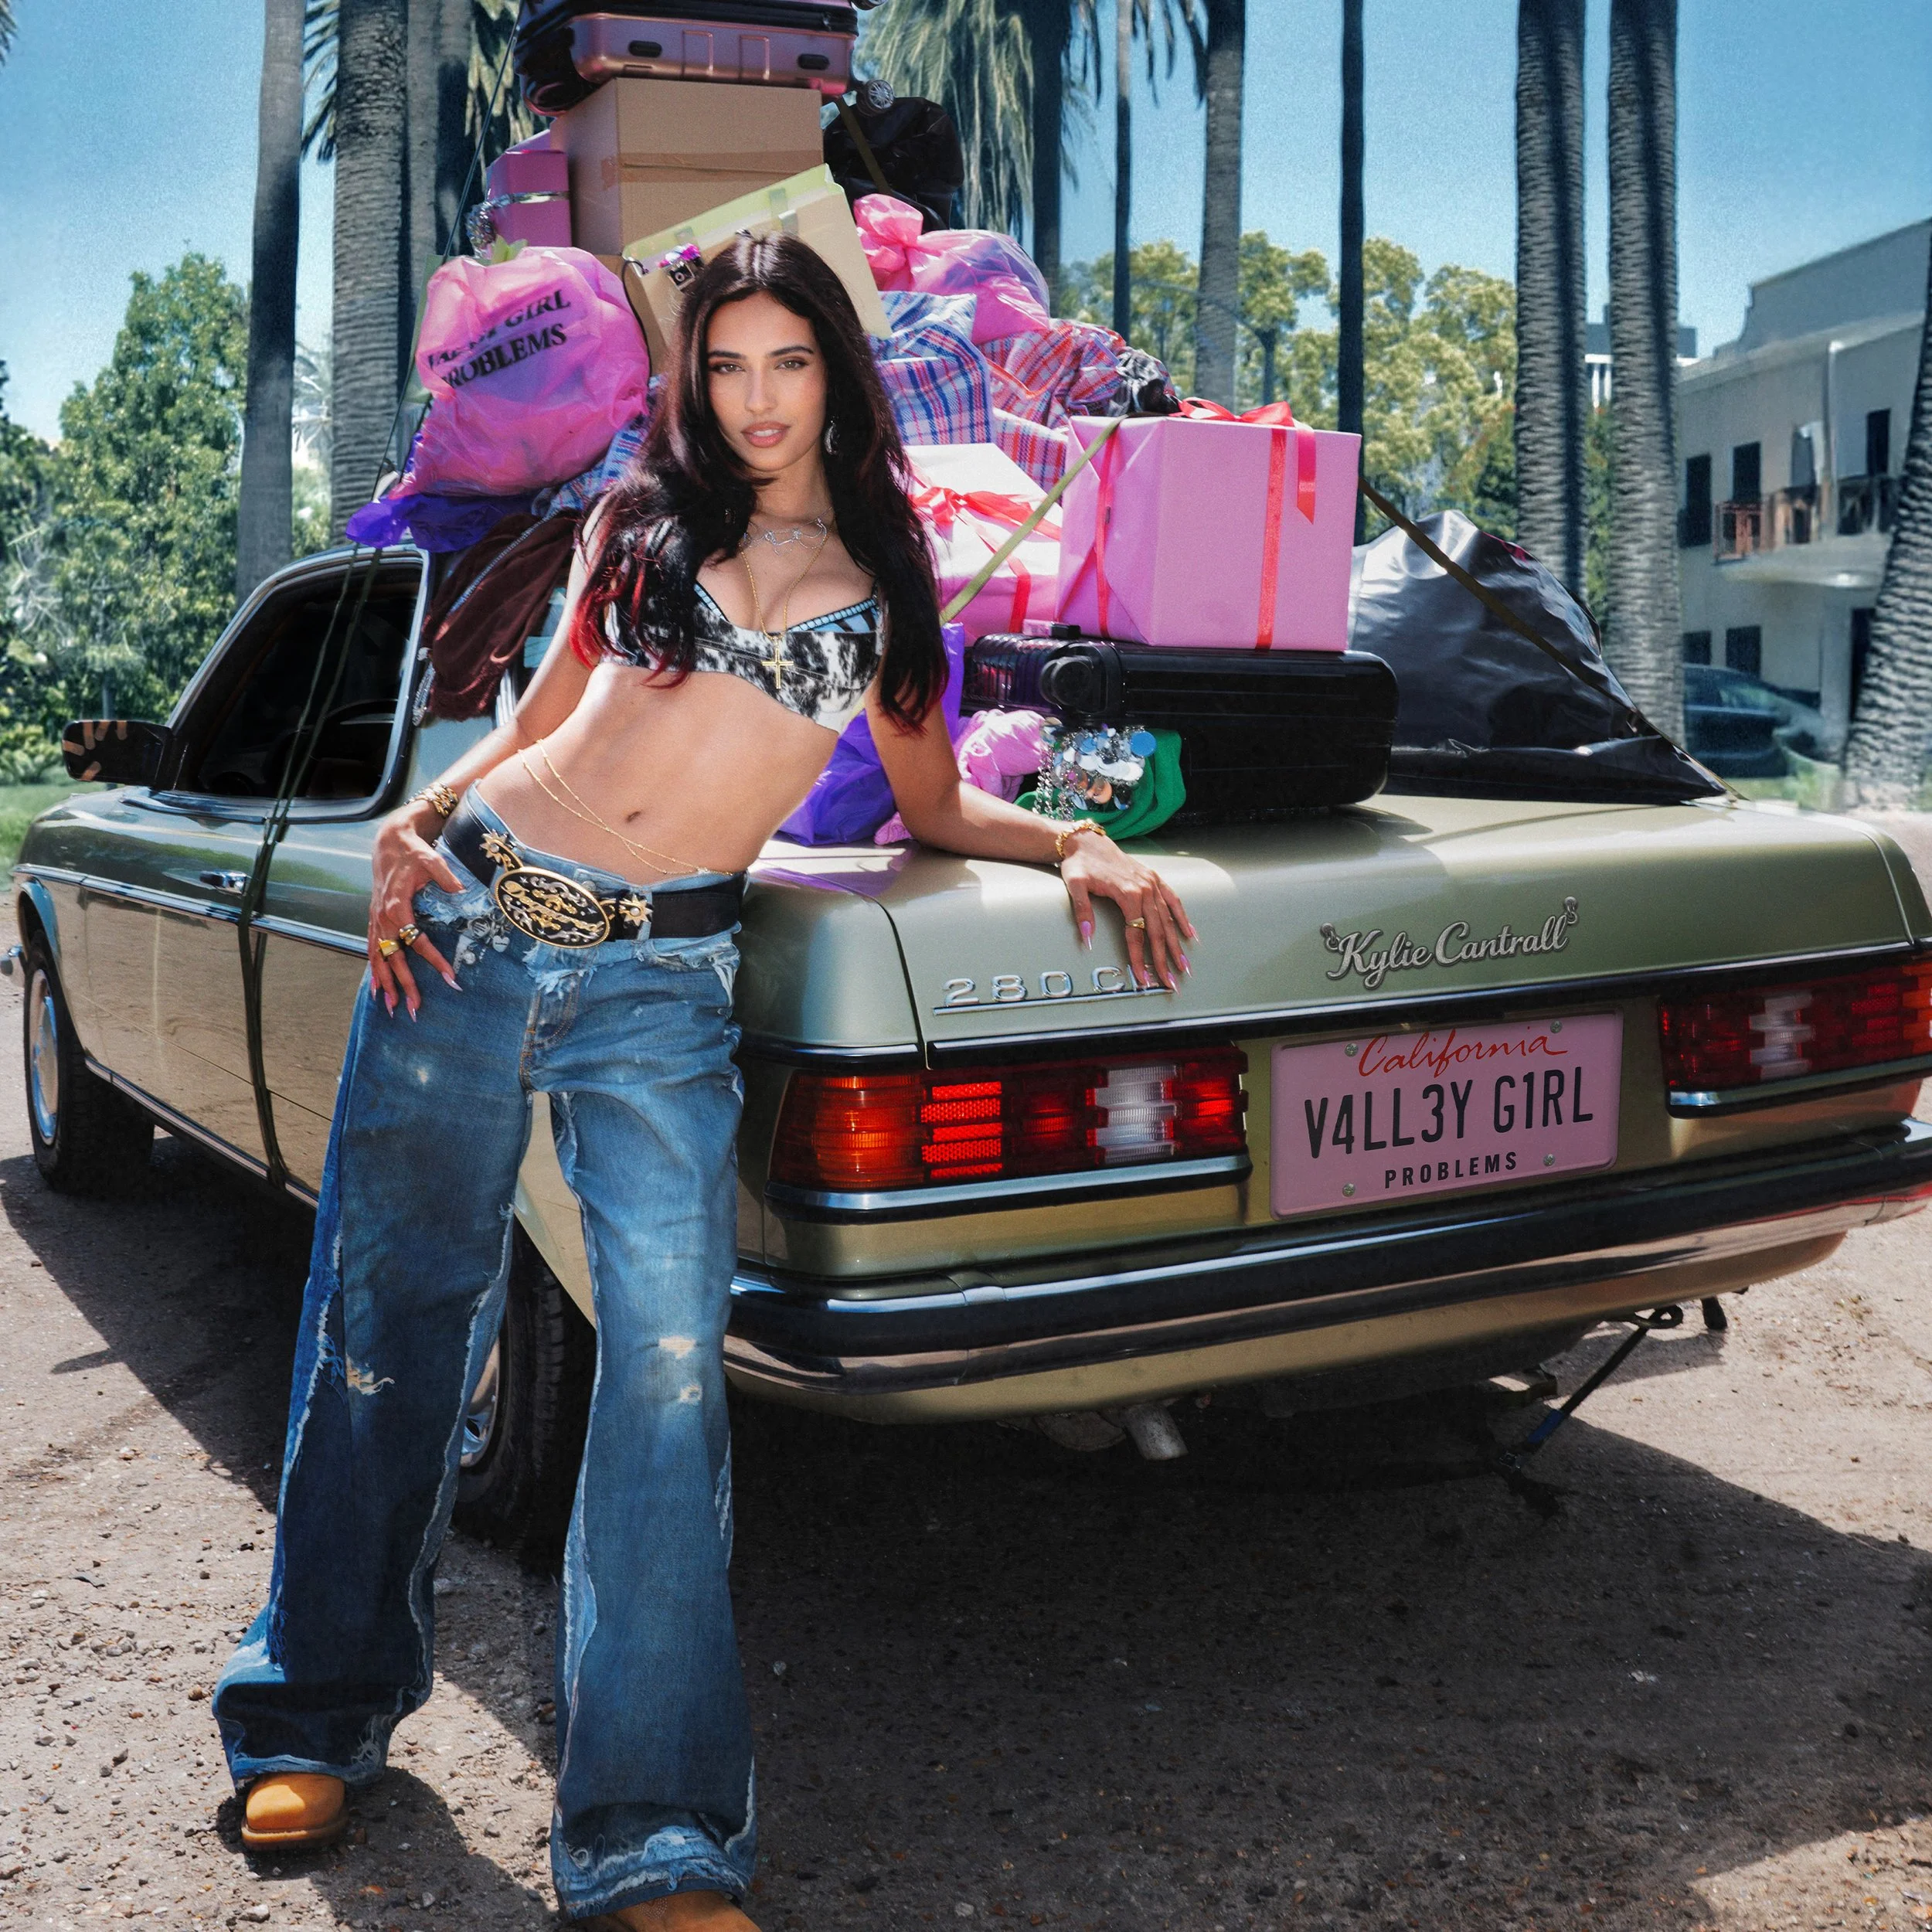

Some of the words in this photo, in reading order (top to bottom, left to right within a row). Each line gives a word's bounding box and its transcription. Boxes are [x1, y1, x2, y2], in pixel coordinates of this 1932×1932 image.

[1326, 929, 1433, 990] Kylie
[1434, 914, 1568, 965] Cantrall
[942, 970, 1073, 1006] 280
[1359, 1026, 1568, 1078] California
[1304, 1080, 1473, 1158] V4LL3Y
[1494, 1066, 1594, 1134] G1RL
[1385, 1151, 1516, 1189] PROBLEMS
